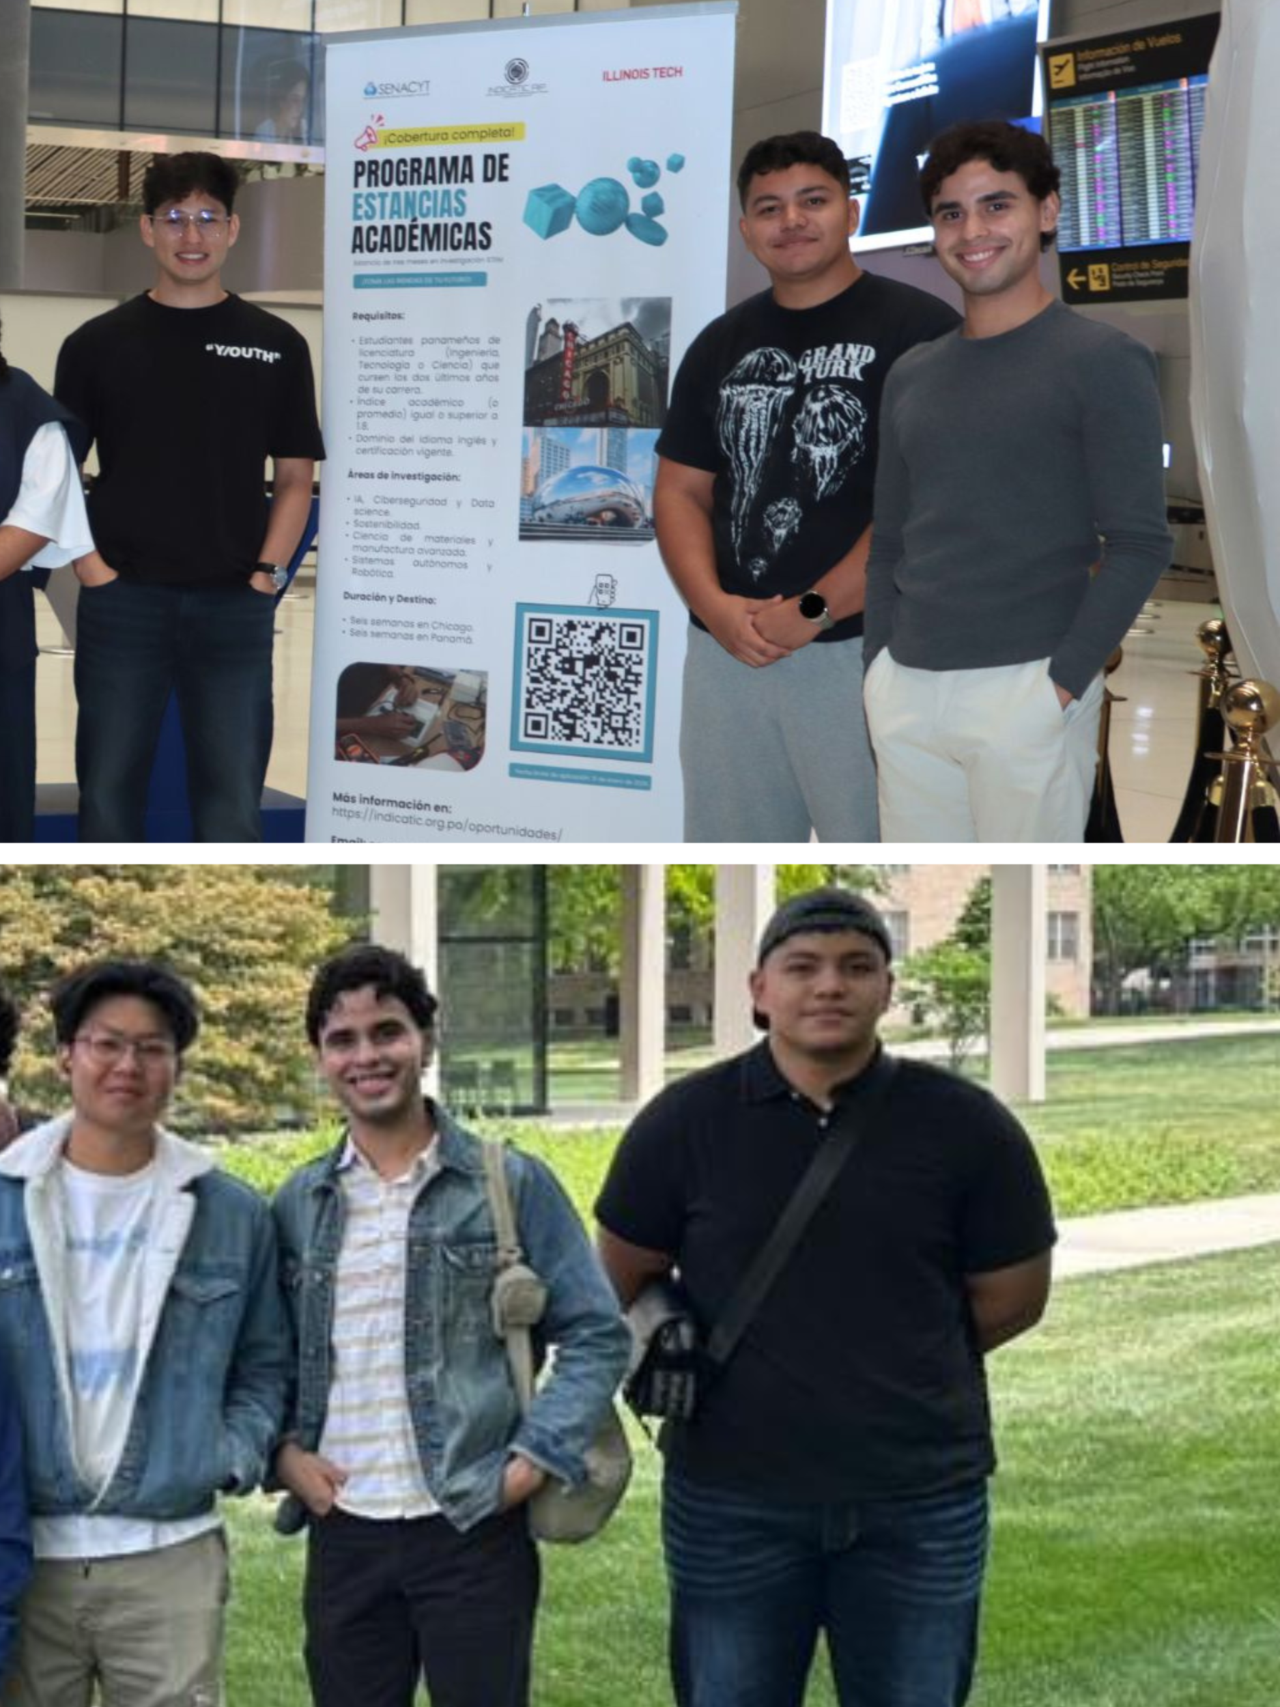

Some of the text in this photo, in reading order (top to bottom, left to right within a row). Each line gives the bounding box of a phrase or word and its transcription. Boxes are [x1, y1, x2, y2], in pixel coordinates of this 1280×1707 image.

[1131, 40, 1146, 51] de
[602, 66, 683, 82] ILLINOIS TECH
[377, 80, 431, 96] SENACYT
[384, 127, 515, 145] ¡Cobertura completa!
[354, 153, 509, 188] PROGRAMA DE
[352, 188, 467, 221] ESTANCIAS
[352, 217, 492, 254] ACADÉMICAS
[352, 311, 405, 322] Requisitos:
[359, 336, 500, 346] Estudiantes panameños de
[798, 343, 876, 370] GRAND
[481, 362, 500, 372] que
[801, 359, 865, 385] TURK
[394, 373, 407, 381] los
[412, 374, 430, 382] dos
[475, 373, 499, 382] años
[358, 386, 369, 394] de
[410, 410, 434, 421] igual
[447, 411, 488, 421] superior
[356, 434, 395, 443] Dominio
[400, 435, 414, 443] del
[377, 471, 389, 479] de
[373, 495, 447, 507] Ciberseguridad
[472, 498, 495, 508] Data
[353, 532, 389, 541] Ciencia
[400, 534, 412, 542] de
[425, 535, 476, 544] materiales
[352, 556, 394, 565] Sistemas
[343, 591, 436, 605] Duración y Destino:
[350, 616, 368, 625] Seis
[370, 618, 414, 628] semanas
[417, 621, 429, 629] en
[350, 628, 368, 637] Seis
[370, 630, 414, 640] semanas
[332, 792, 452, 814] Más información en:
